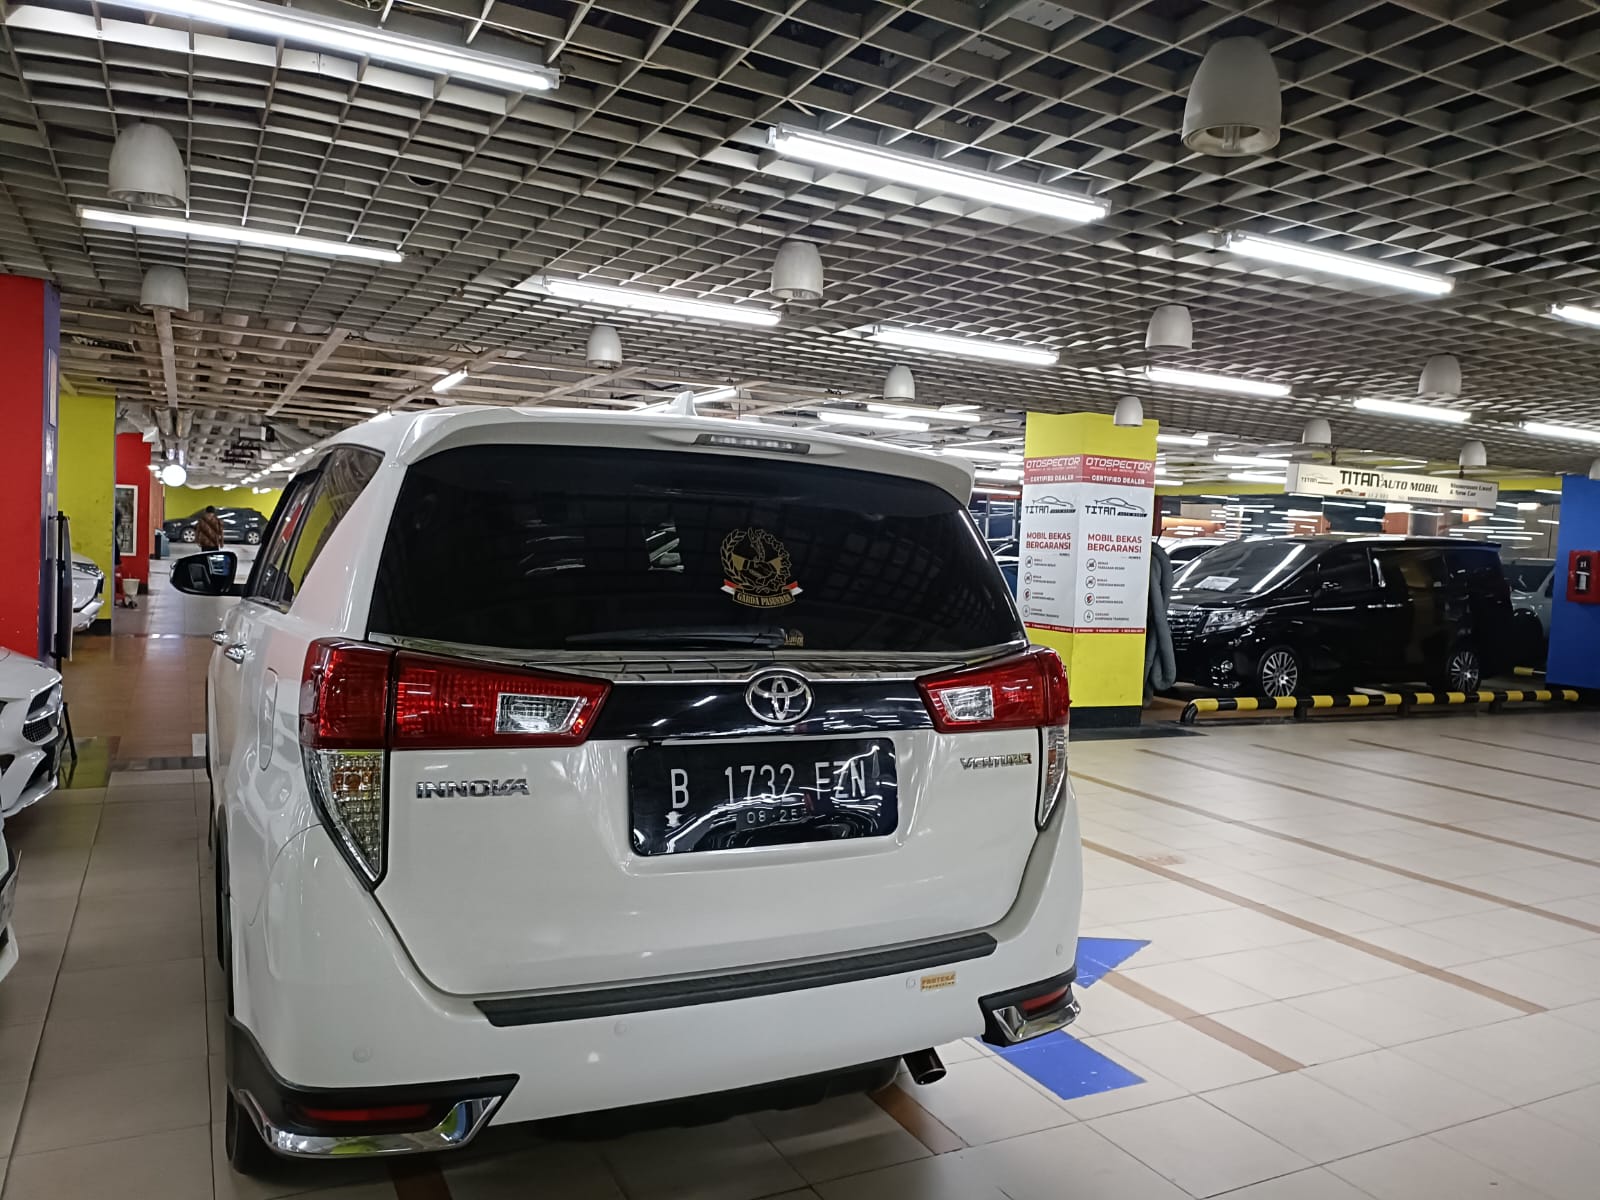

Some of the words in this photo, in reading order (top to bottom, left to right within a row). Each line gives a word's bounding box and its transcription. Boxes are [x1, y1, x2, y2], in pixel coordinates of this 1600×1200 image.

[1026, 456, 1080, 468] OTOSPECTOR
[1086, 457, 1152, 471] OTOSPECTOR
[1091, 475, 1121, 483] CERTIFIED
[1122, 477, 1145, 485] DEALER
[1381, 479, 1407, 491] AUTO
[1409, 482, 1440, 494] MOBIL
[1025, 505, 1049, 514] TITAN
[1085, 505, 1116, 516] TITAN
[1026, 532, 1047, 540] MOBIL
[1048, 532, 1071, 540] BEKAS
[1088, 533, 1114, 542] MOBIL
[1115, 534, 1142, 544] BEKAS
[1026, 541, 1071, 550] BERGARANSI
[1087, 543, 1142, 553] BERGARANSI
[737, 592, 760, 606] GARDA
[960, 753, 1032, 770] VENTURE
[416, 778, 530, 798] INNOVA
[670, 768, 690, 809] B
[724, 763, 796, 805] 1732
[815, 760, 867, 800] FZN
